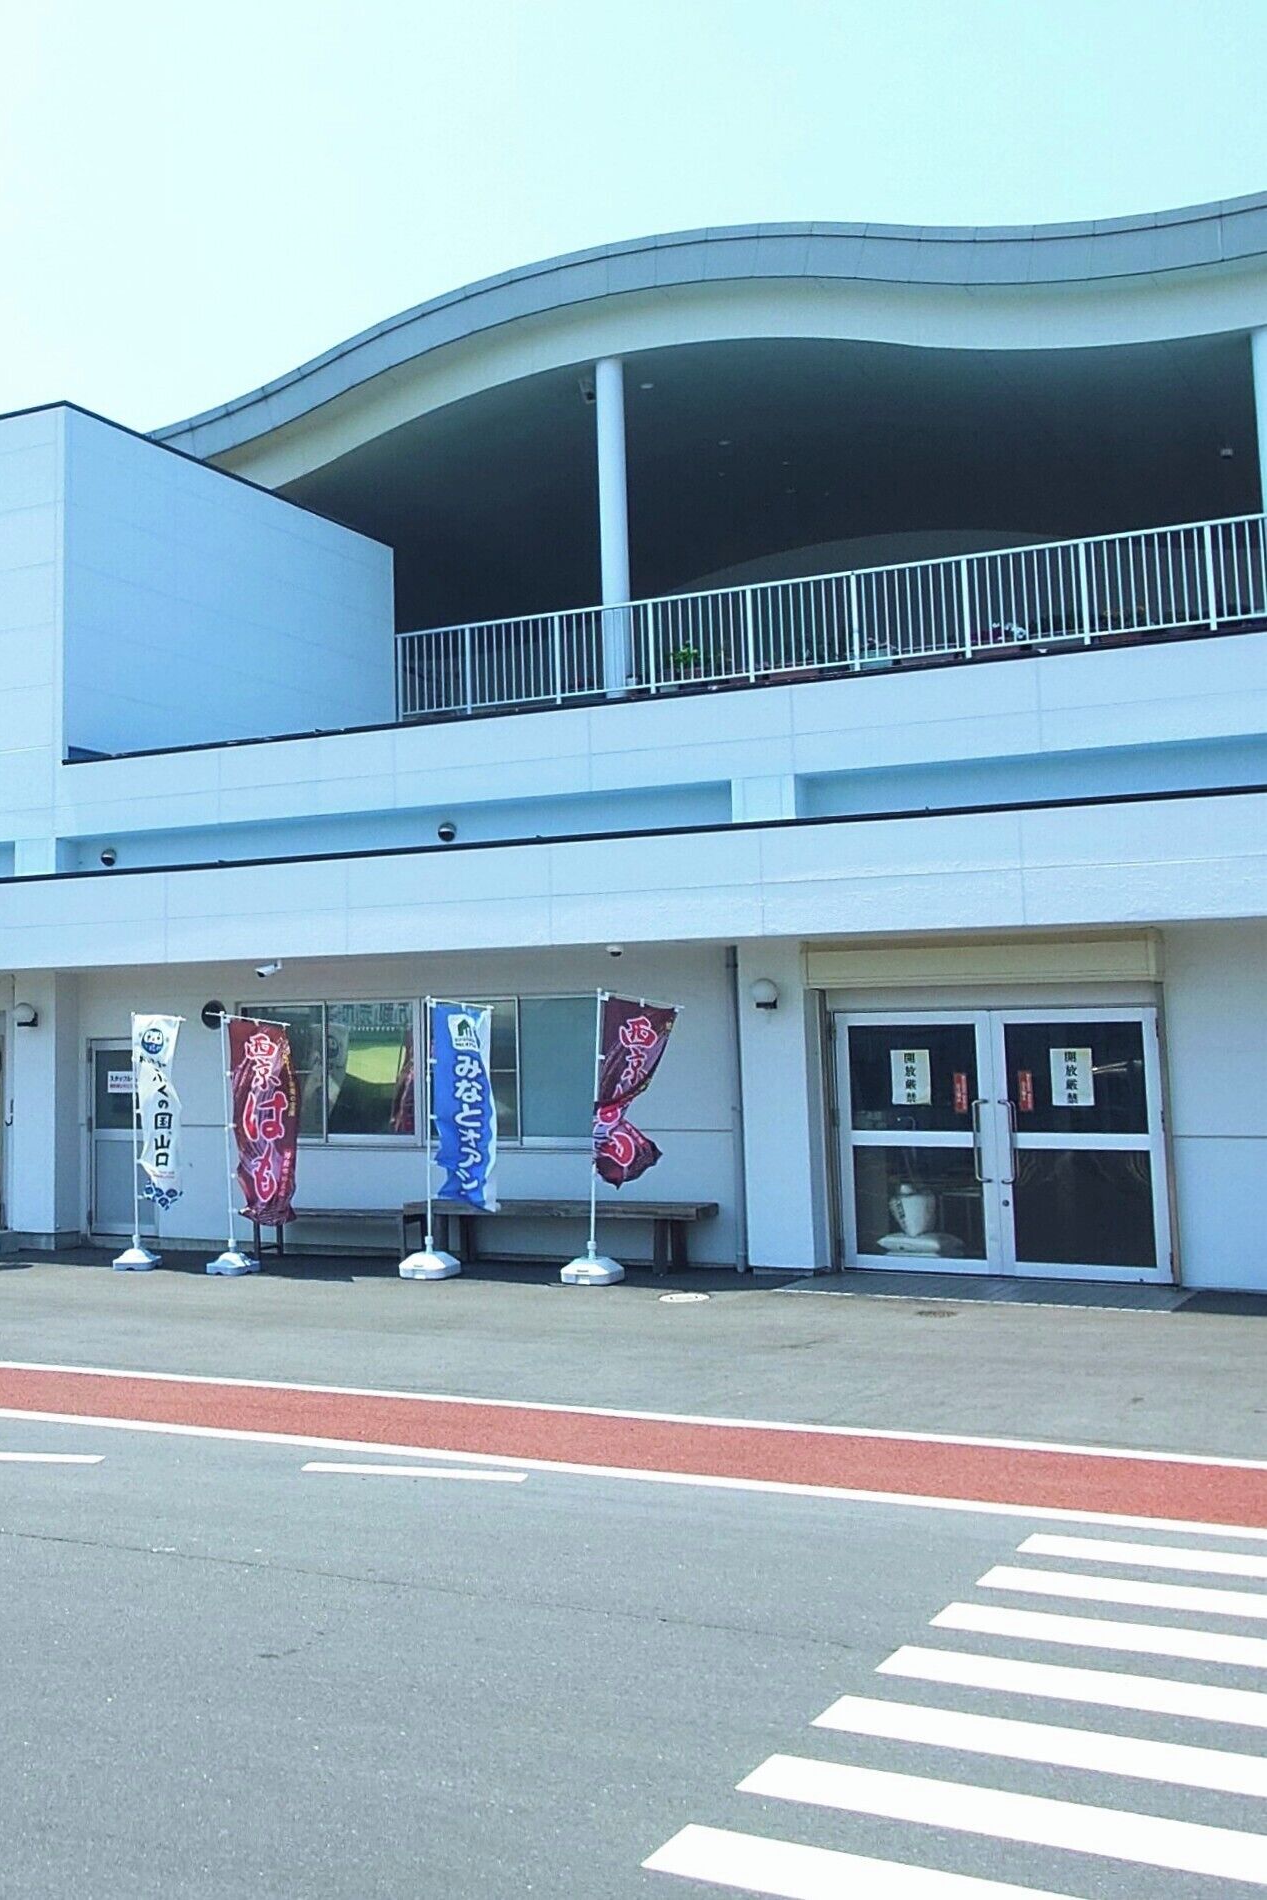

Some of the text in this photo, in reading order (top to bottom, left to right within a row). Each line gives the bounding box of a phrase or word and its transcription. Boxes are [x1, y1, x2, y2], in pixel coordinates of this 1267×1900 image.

[903, 1052, 917, 1104] 開放厳禁
[1063, 1051, 1078, 1104] 開放厳禁
